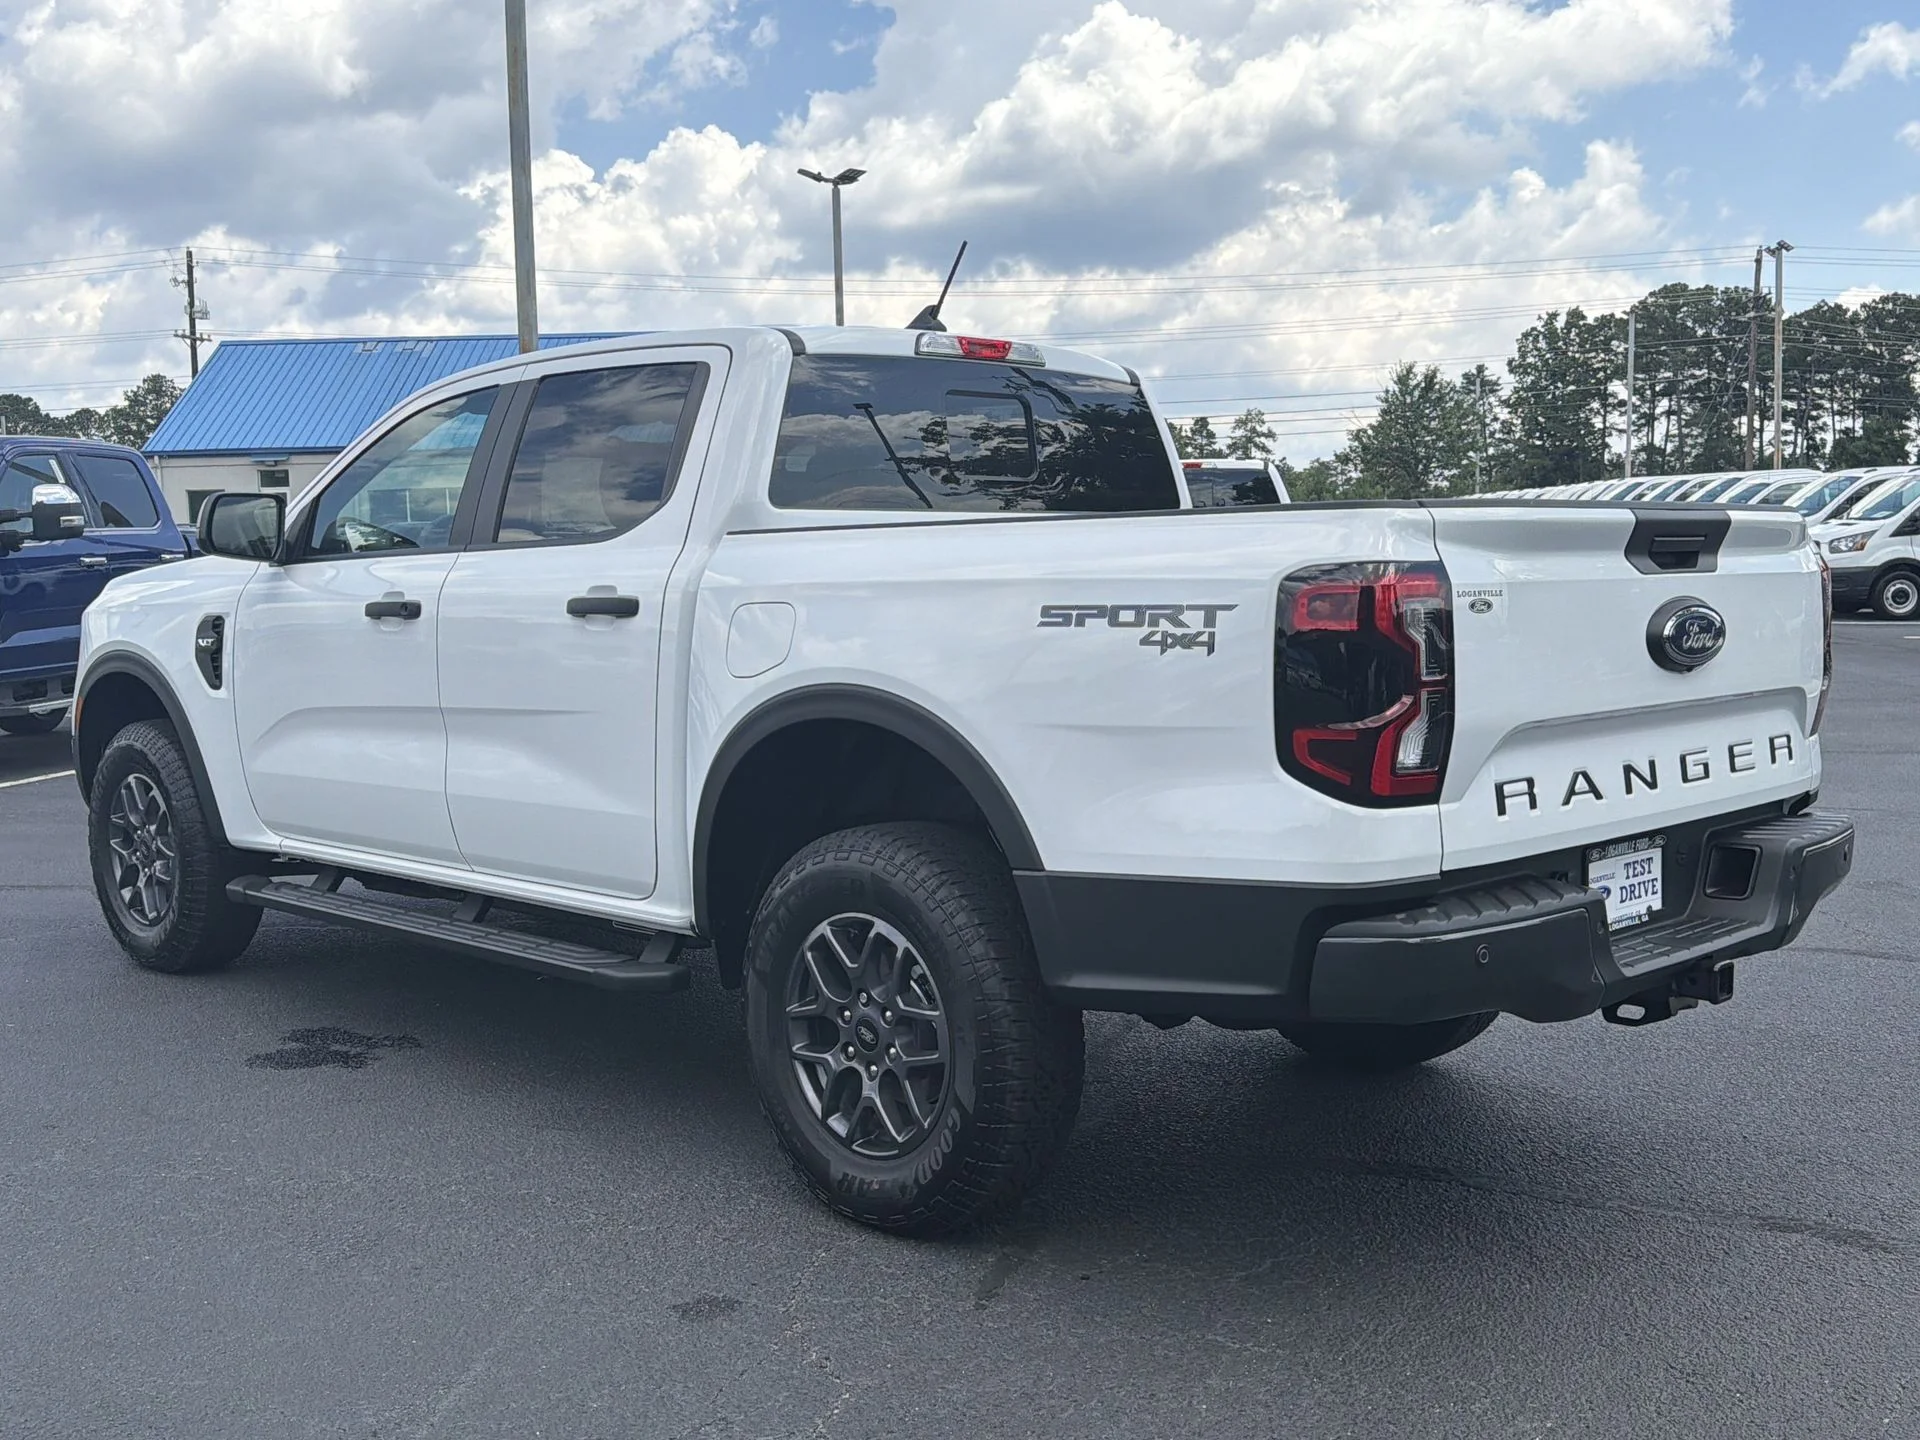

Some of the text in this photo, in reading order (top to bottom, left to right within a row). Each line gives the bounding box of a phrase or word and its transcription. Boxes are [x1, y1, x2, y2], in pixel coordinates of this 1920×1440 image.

[1456, 590, 1503, 598] LOGANVILLE
[1037, 603, 1239, 628] SPORT
[1139, 630, 1216, 657] 4x4
[1682, 619, 1714, 649] Ford
[1494, 734, 1794, 817] RANGER
[1605, 841, 1635, 857] LOGANVILLE
[1636, 838, 1649, 850] FORD
[1589, 872, 1615, 884] OGANVILLE
[1623, 857, 1654, 880] TEST
[1619, 878, 1658, 904] DRIVE
